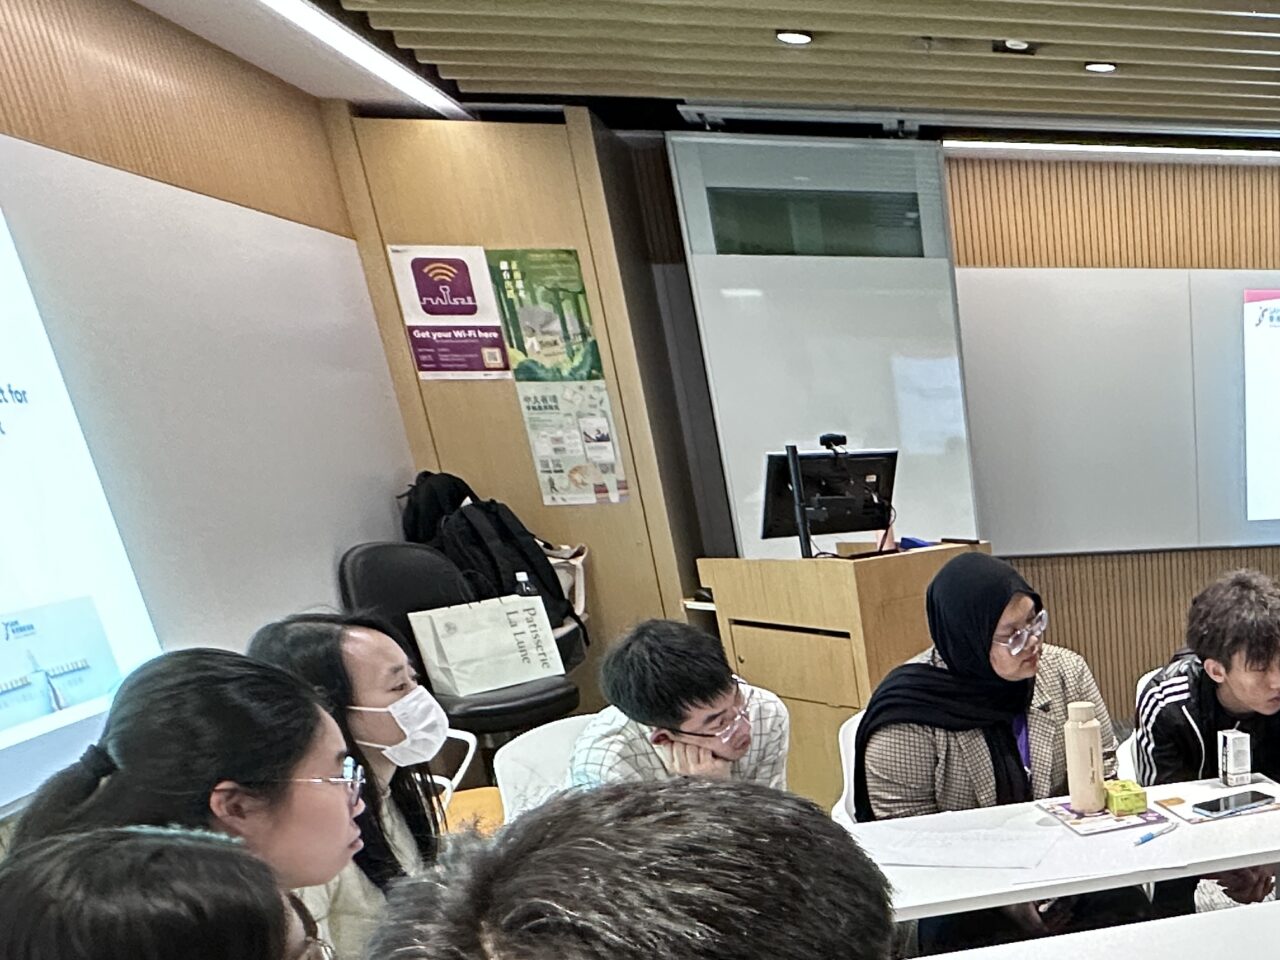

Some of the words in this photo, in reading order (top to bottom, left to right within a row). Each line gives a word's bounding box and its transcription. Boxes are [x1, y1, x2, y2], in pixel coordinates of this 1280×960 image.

[413, 329, 431, 339] Get
[431, 330, 451, 341] your
[452, 329, 477, 339] Wi-Fi
[478, 329, 499, 340] here
[8, 384, 28, 404] for
[506, 610, 519, 628] La
[513, 631, 532, 665] Lune
[522, 607, 551, 670] Patisserie
